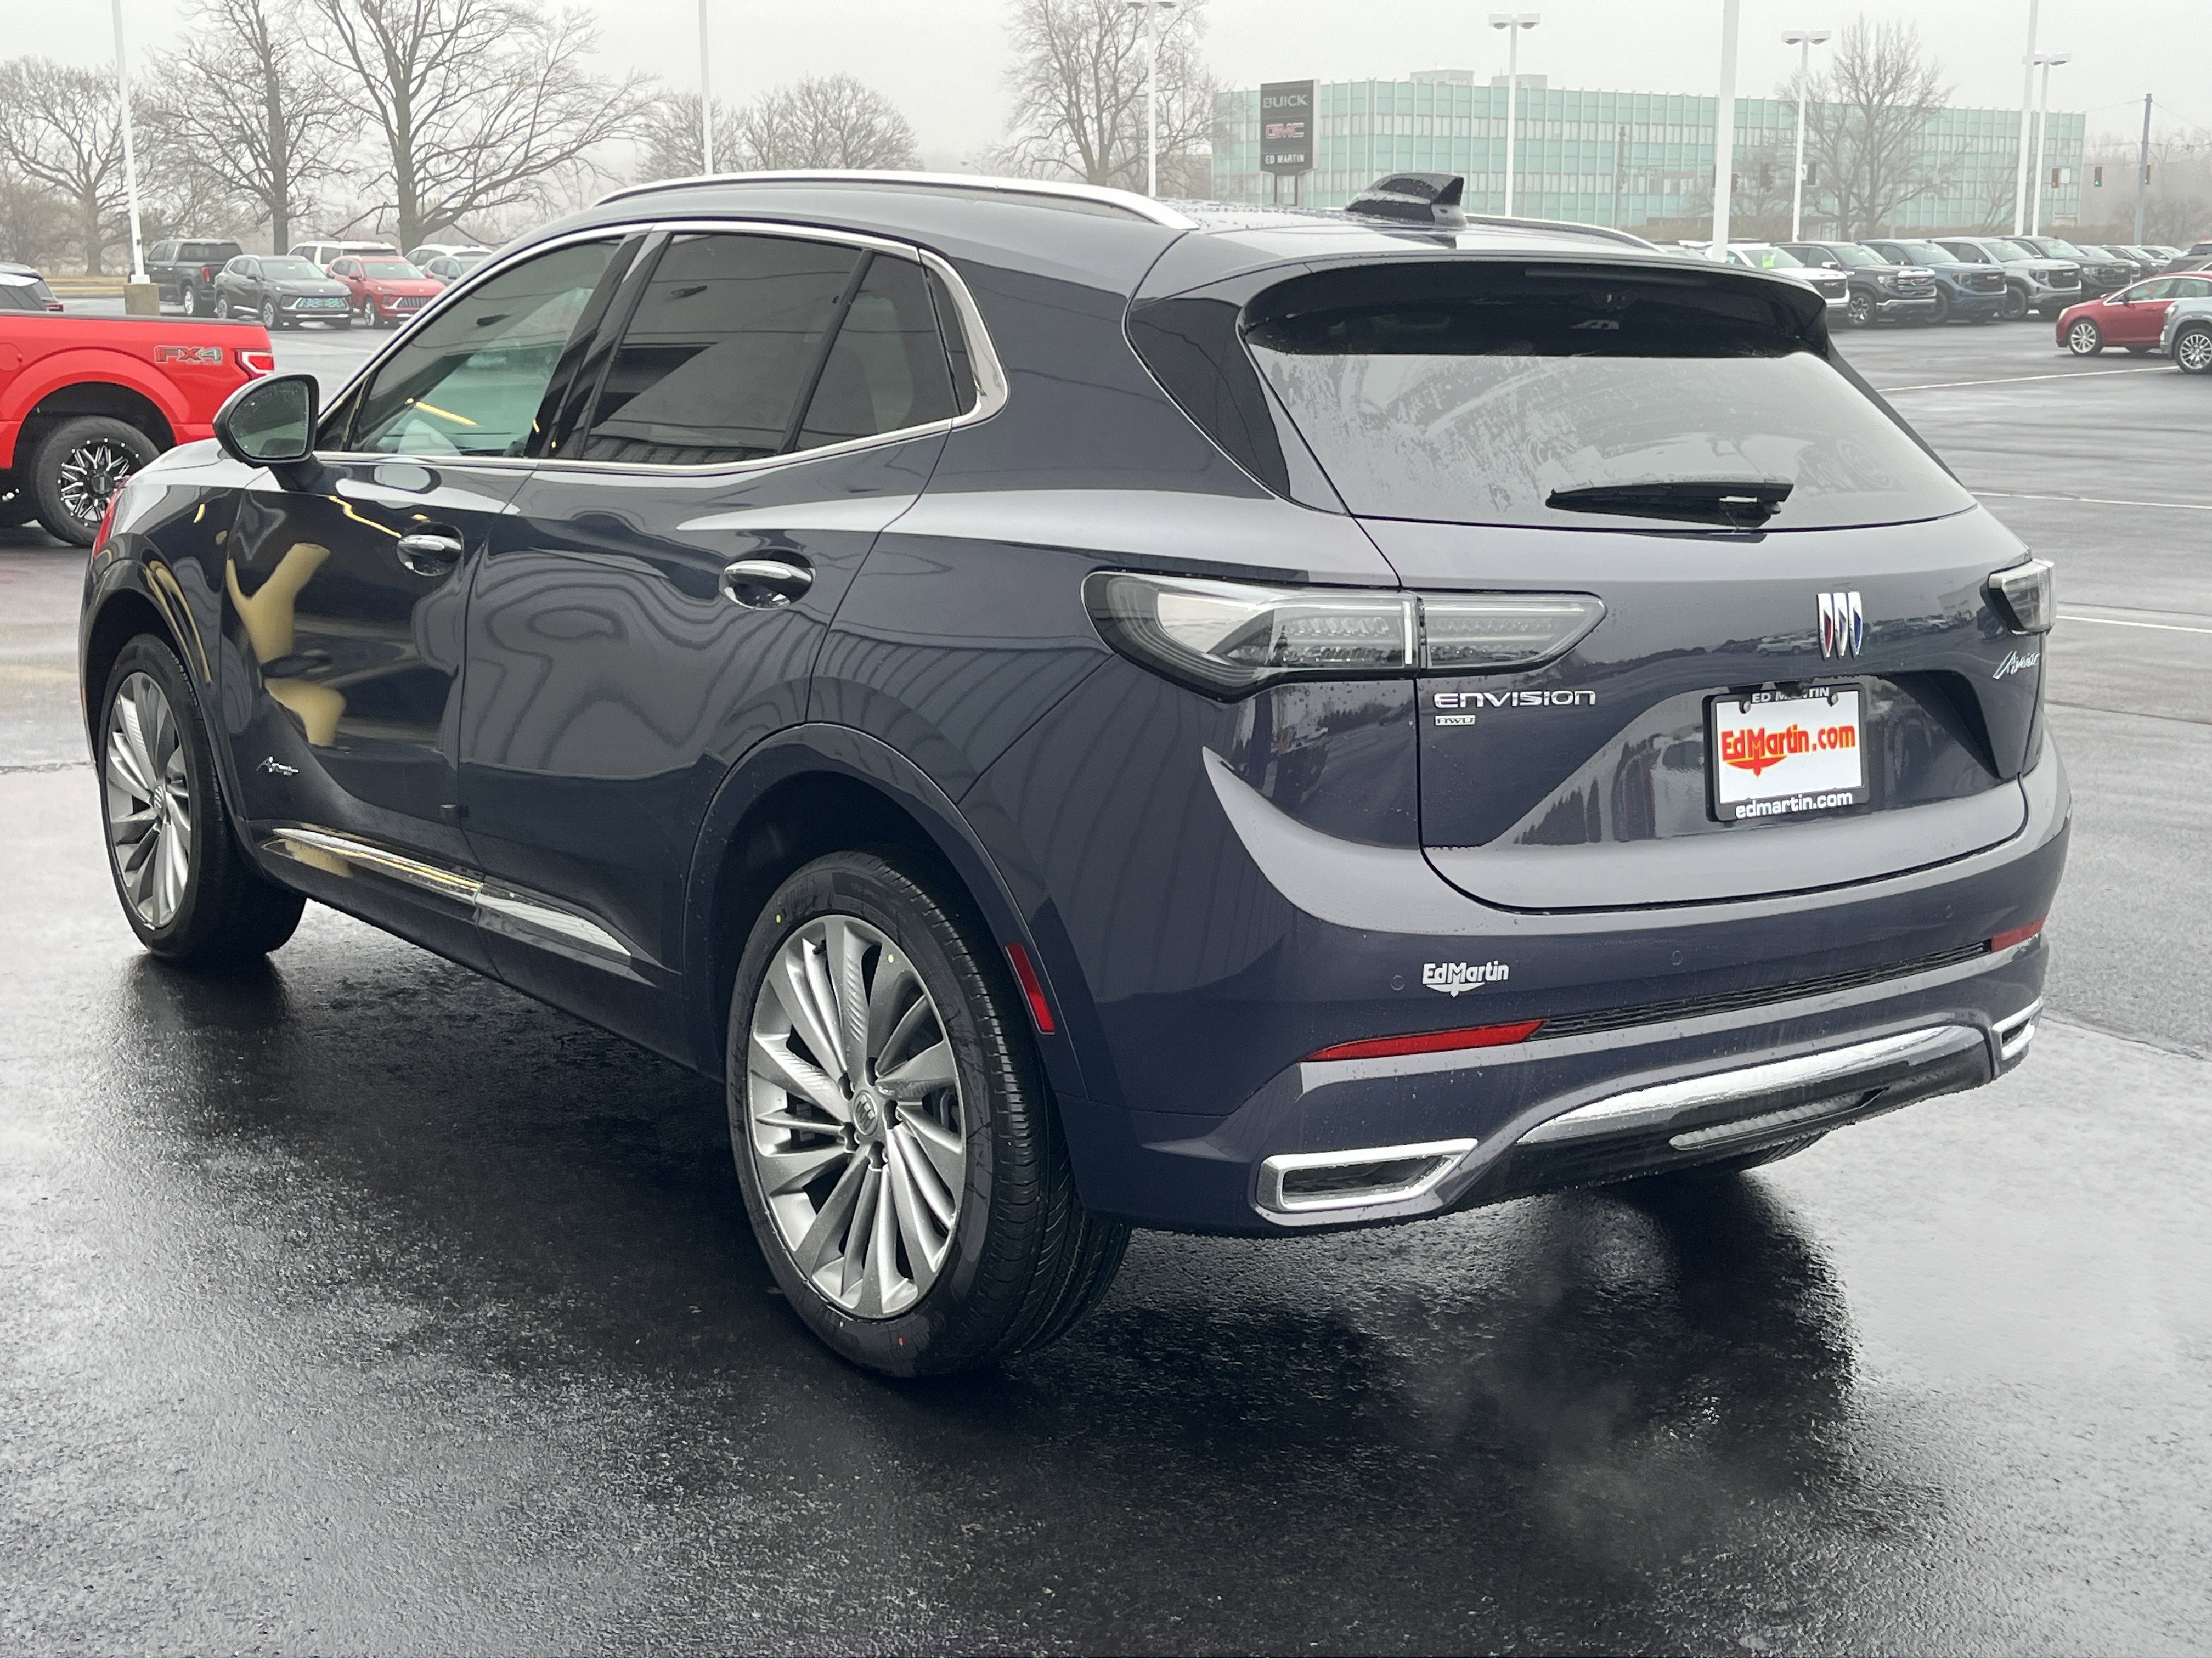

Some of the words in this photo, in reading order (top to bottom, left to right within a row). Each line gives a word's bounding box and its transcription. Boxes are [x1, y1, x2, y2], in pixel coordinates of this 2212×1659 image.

[1263, 94, 1308, 108] BUICK
[1266, 122, 1304, 139] GMC
[1265, 155, 1275, 164] ED
[1277, 154, 1305, 163] MARTIN
[154, 345, 223, 363] FX4
[1433, 690, 1596, 708] ENVISION
[1752, 692, 1771, 703] ED
[1775, 687, 1830, 701] MTIN
[1720, 723, 1857, 761] EdMartin.com
[1735, 792, 1853, 819] edmartin.com
